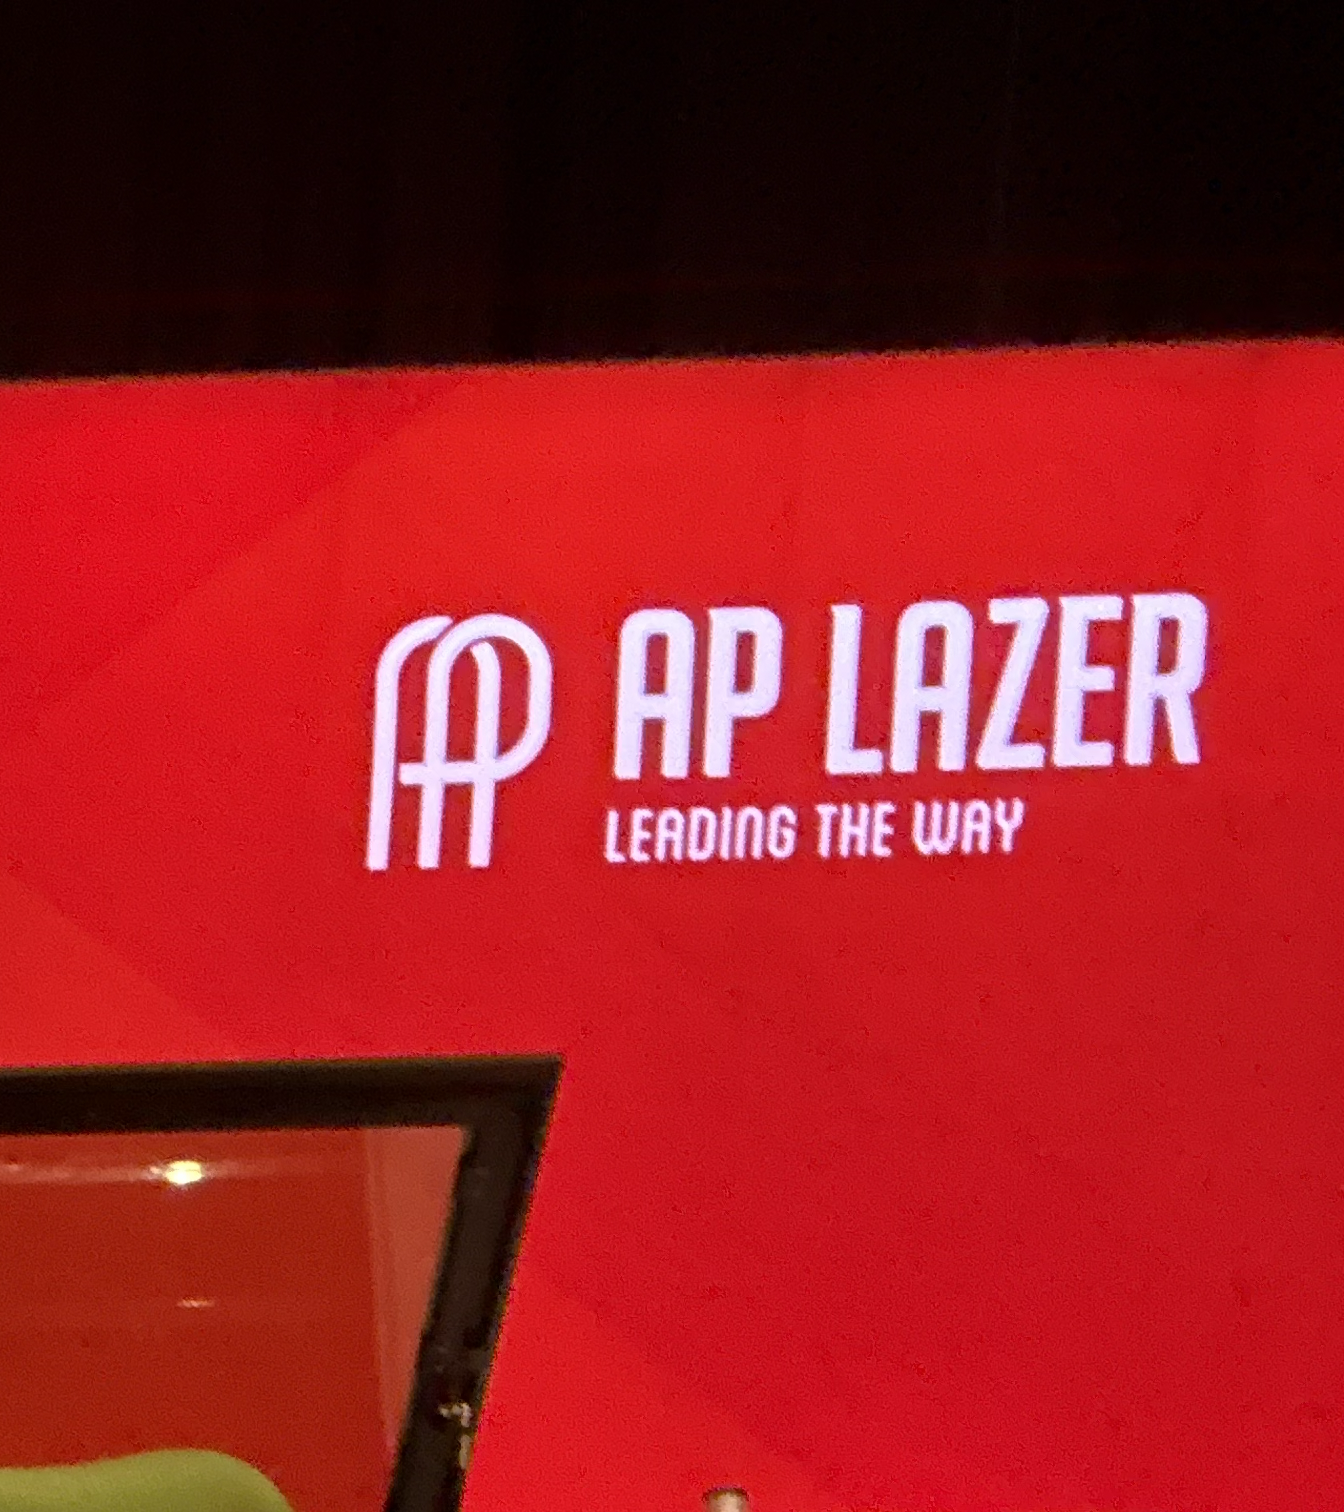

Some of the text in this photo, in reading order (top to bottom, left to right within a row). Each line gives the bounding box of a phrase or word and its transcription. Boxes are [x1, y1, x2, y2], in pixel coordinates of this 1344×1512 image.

[614, 592, 1207, 780] AP LAZER
[605, 798, 1025, 864] LEADING THE WAY
